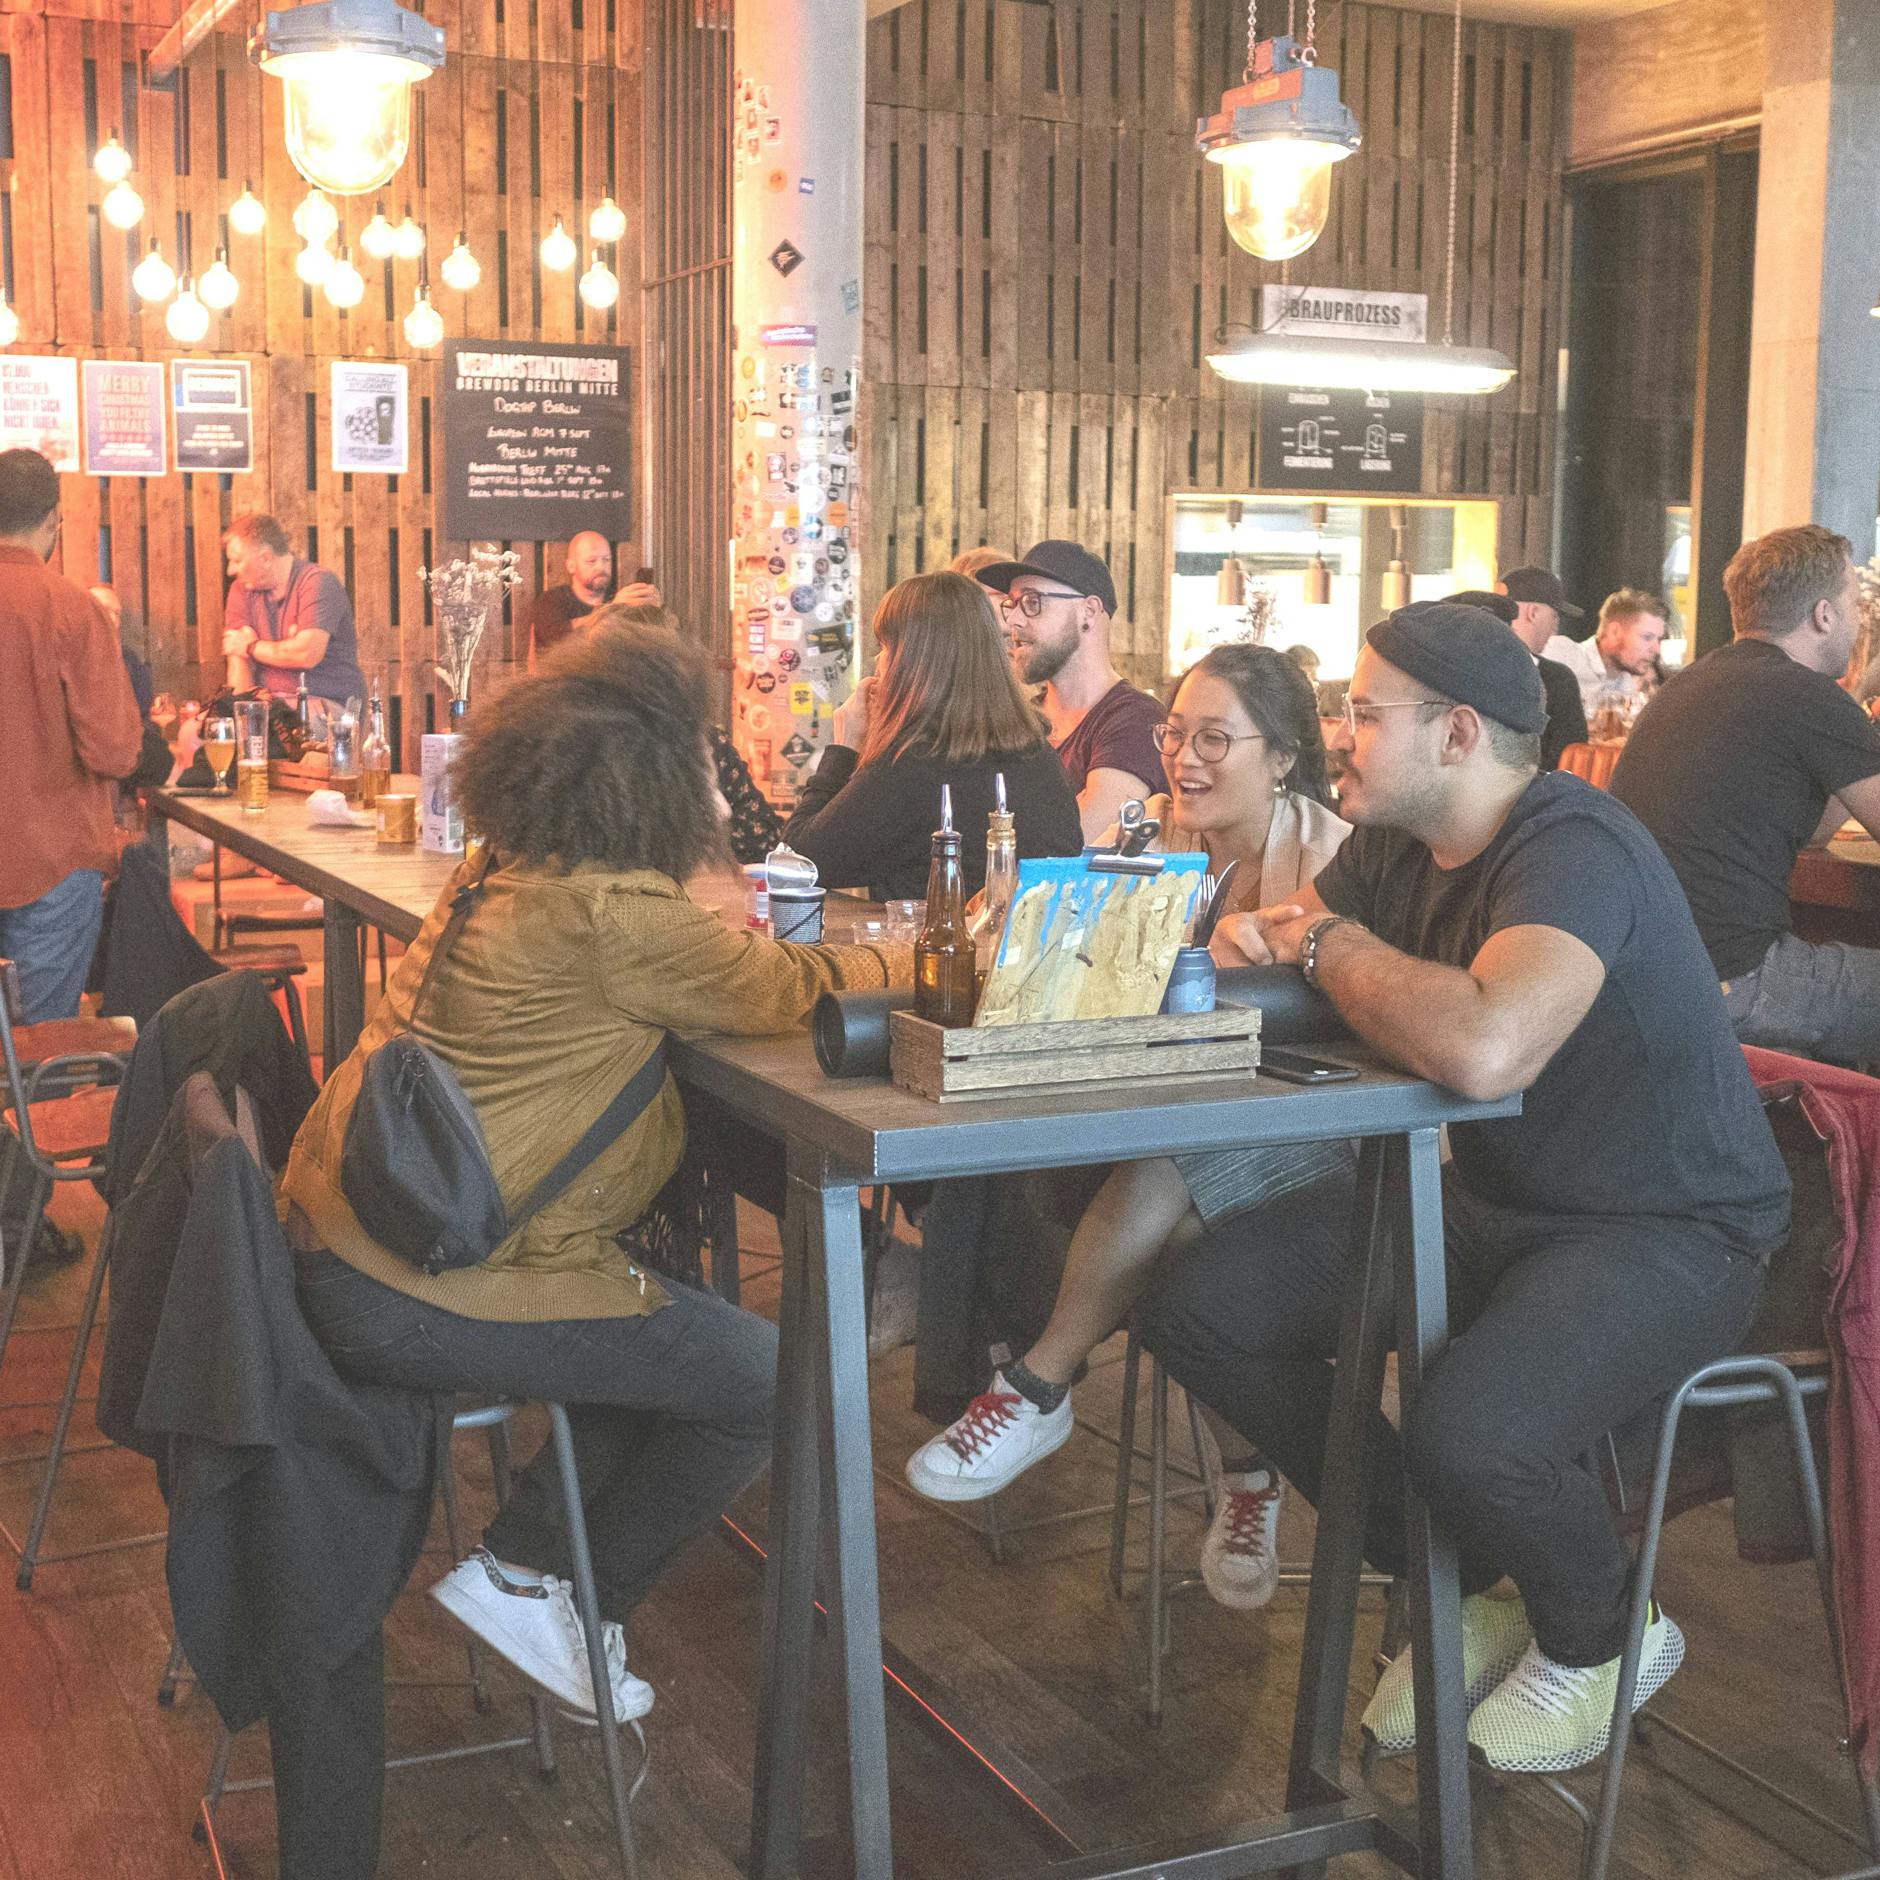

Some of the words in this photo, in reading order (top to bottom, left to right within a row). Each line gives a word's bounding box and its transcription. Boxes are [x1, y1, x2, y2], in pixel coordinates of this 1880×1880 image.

[1290, 299, 1400, 325] BRAUPROZESS
[456, 352, 618, 382] VERANSTALTUNGEN
[97, 375, 150, 393] MERRY
[456, 376, 519, 392] BREWDOG
[525, 379, 573, 394] BERLIN
[579, 382, 618, 396] MITTE
[541, 399, 582, 415] BERLIN
[100, 419, 152, 432] ANIMALS
[558, 428, 568, 439] 7
[569, 428, 591, 439] SEPT
[496, 443, 537, 459] BERLIN
[543, 446, 578, 458] MITTE
